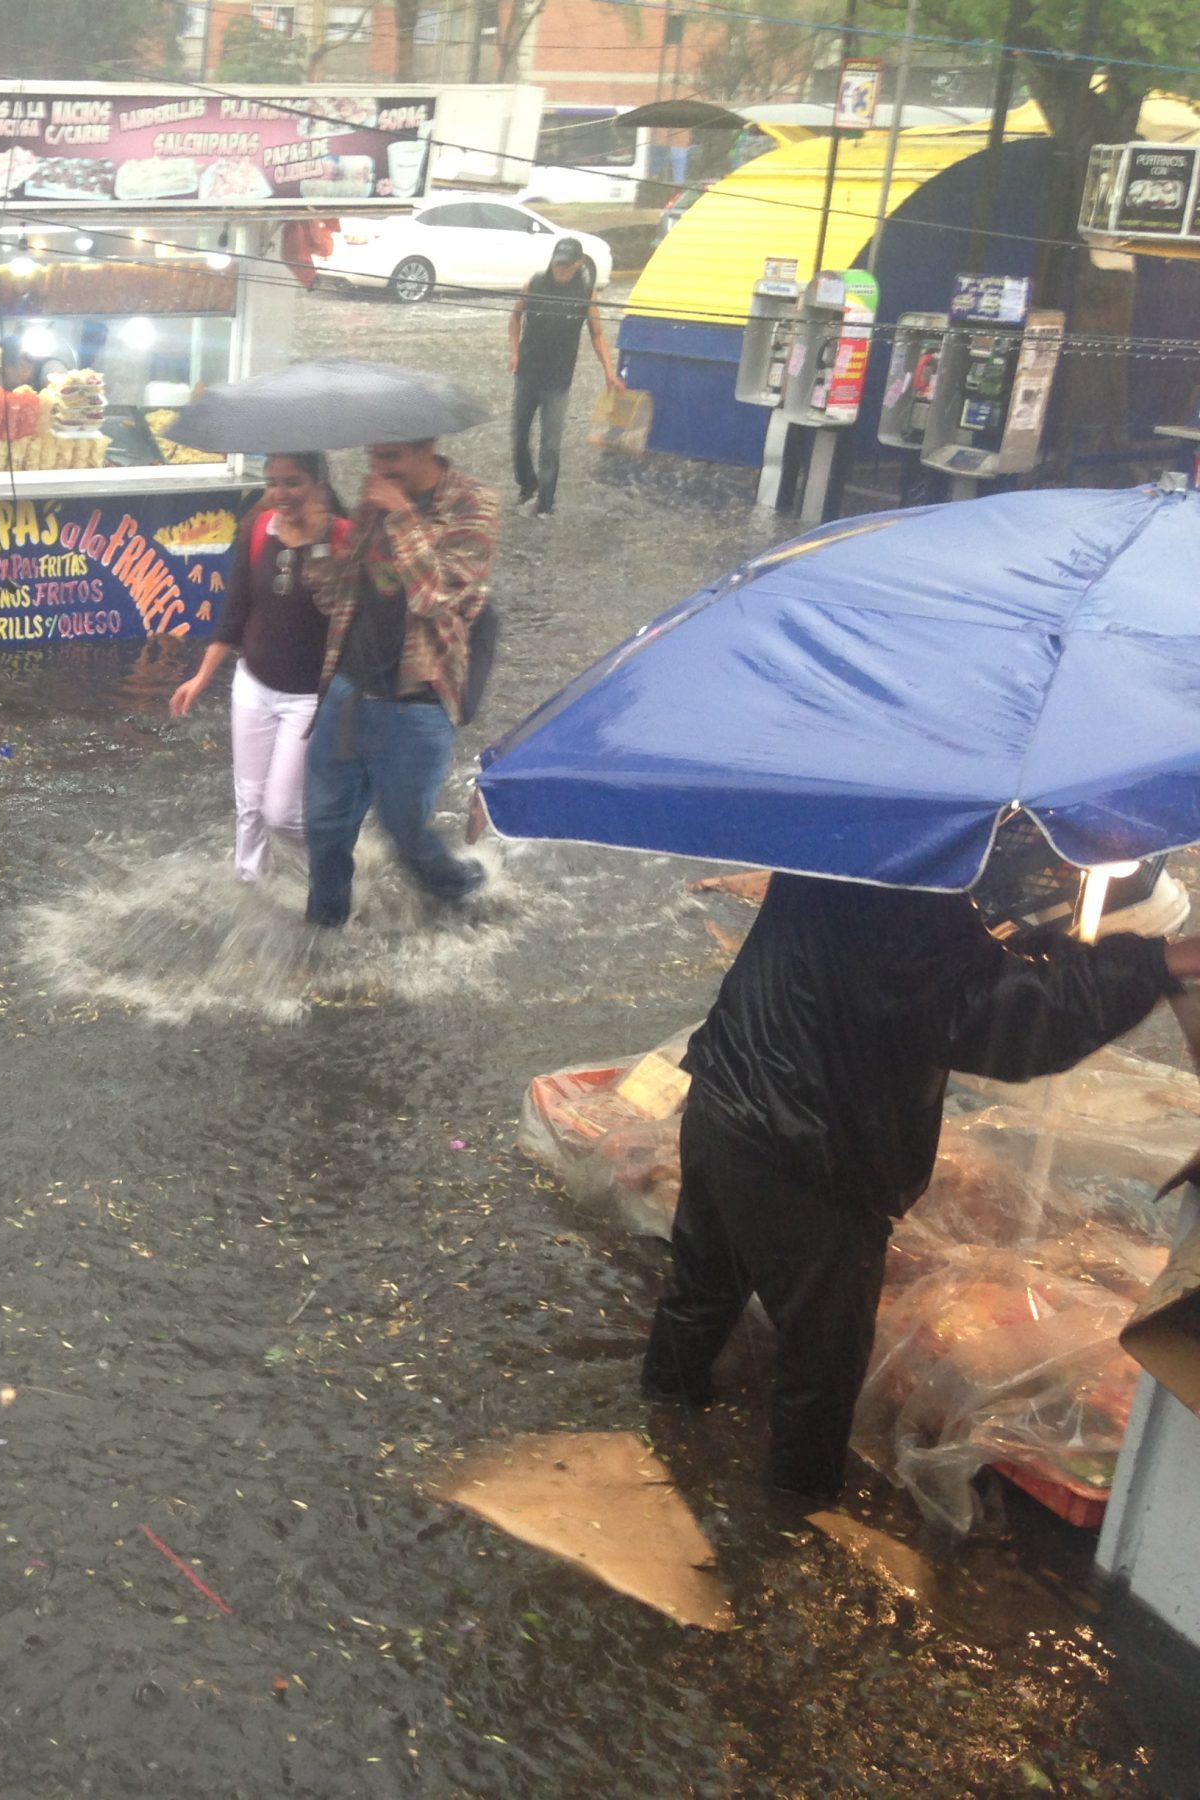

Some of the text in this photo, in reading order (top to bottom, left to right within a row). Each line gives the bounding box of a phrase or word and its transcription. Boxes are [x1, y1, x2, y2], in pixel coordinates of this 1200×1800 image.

[27, 101, 46, 118] LA
[51, 101, 113, 125] NACHOS
[153, 132, 260, 157] SALCHIPAPAS
[263, 142, 308, 169] PAPAS
[39, 551, 89, 578] FRITAS
[32, 578, 104, 607] FRITOS
